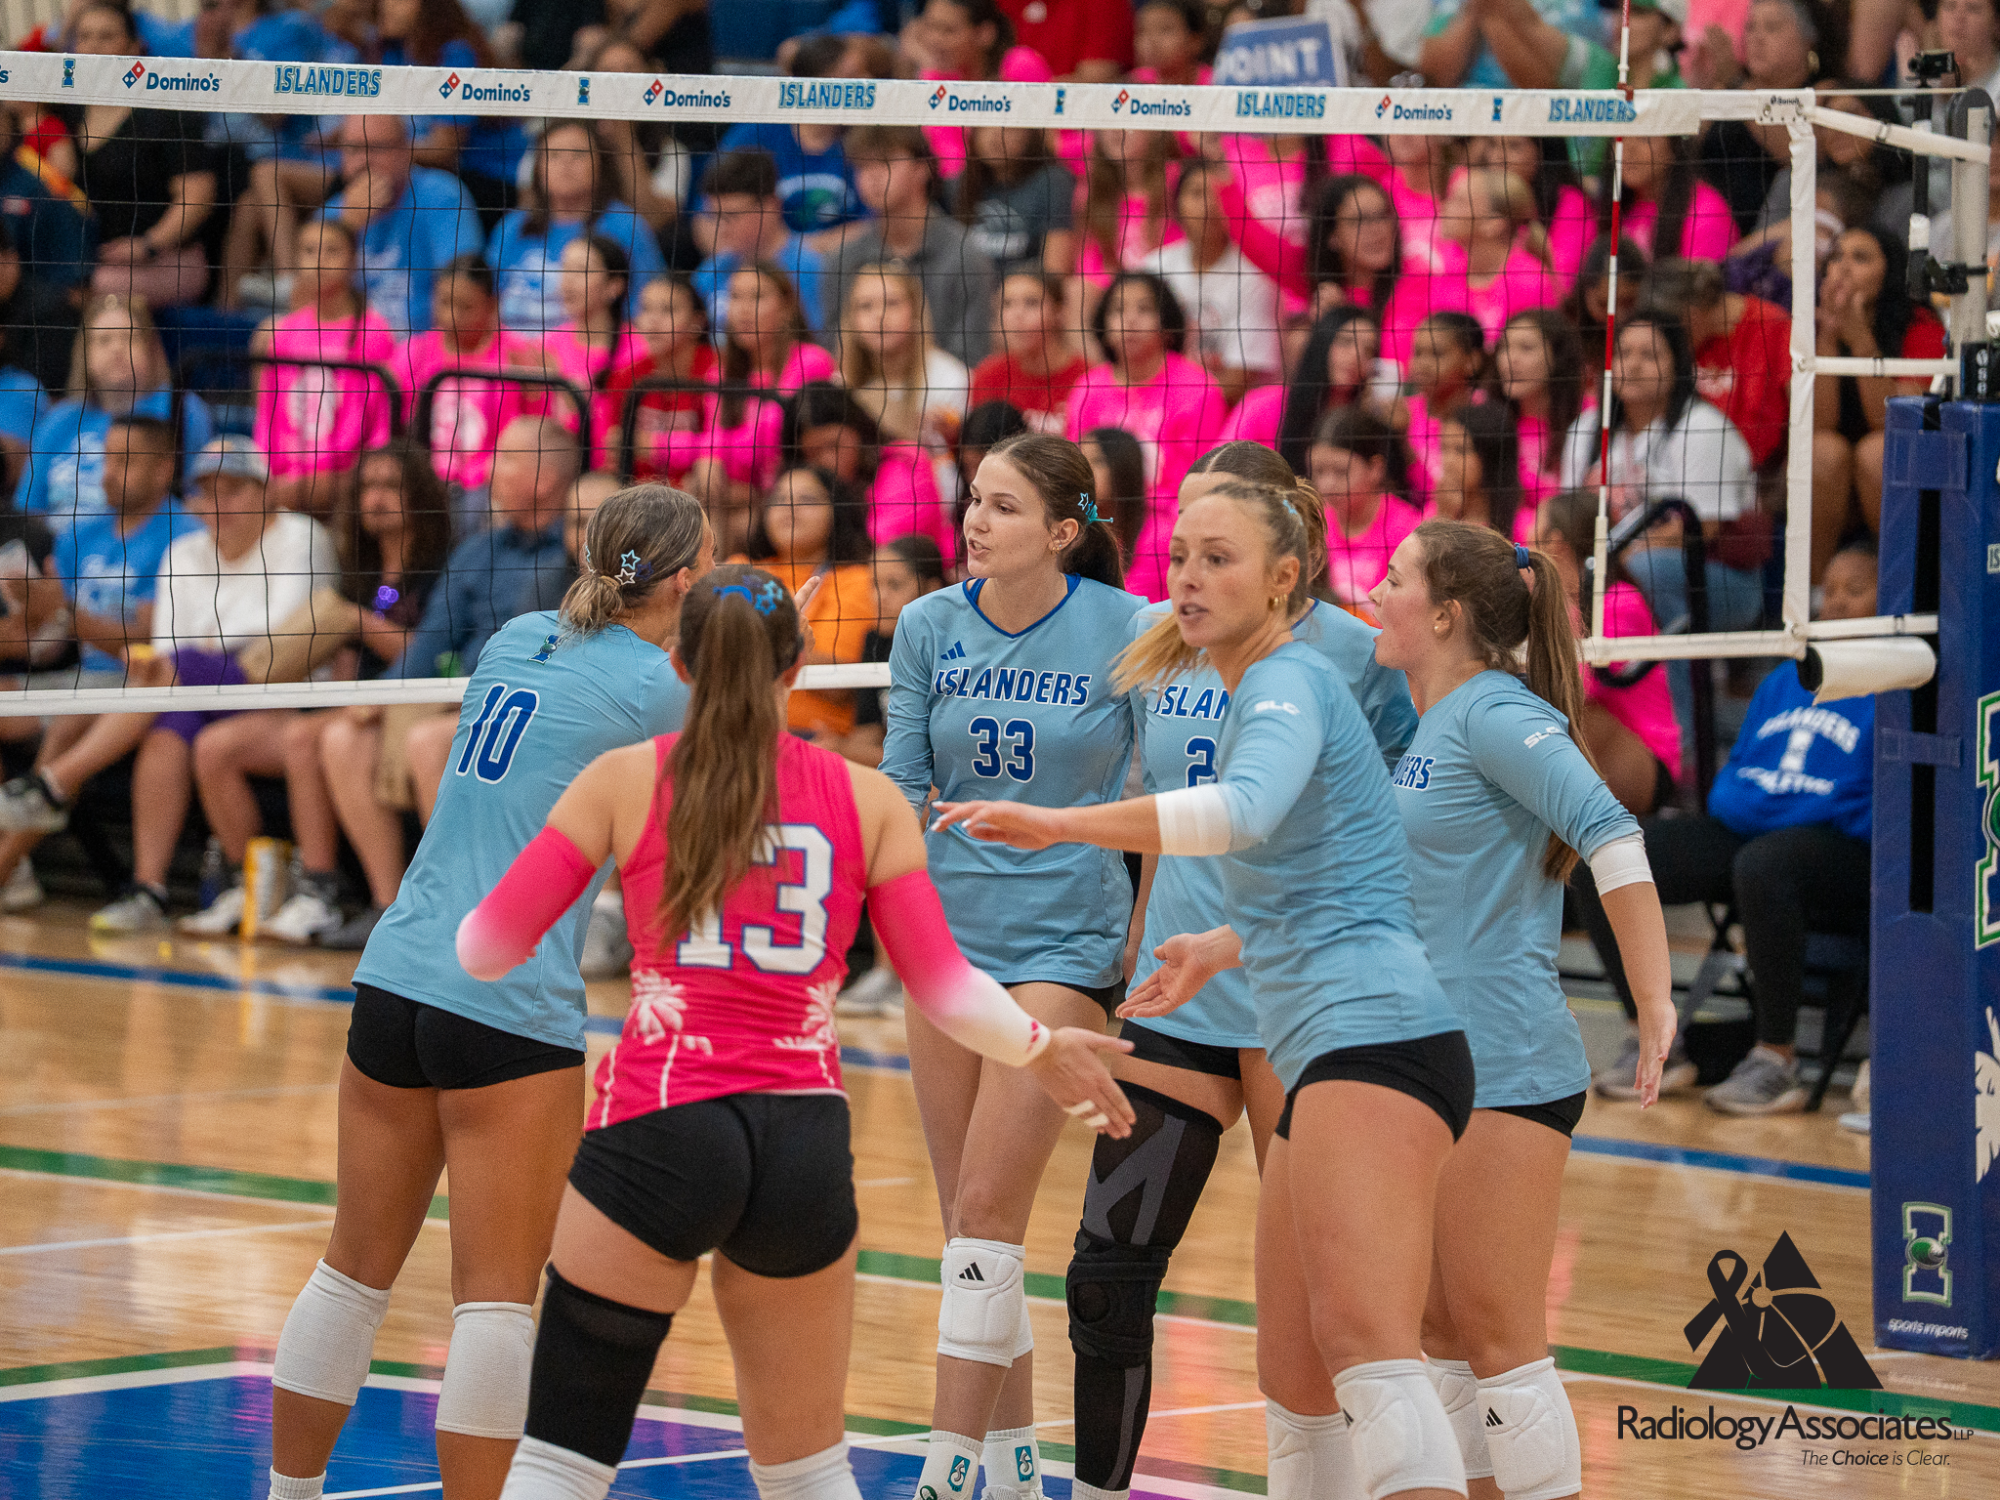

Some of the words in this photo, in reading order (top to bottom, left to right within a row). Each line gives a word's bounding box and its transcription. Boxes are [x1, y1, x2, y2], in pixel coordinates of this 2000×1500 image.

[146, 72, 220, 92] Domino's
[274, 65, 382, 98] ISLANDERS
[462, 83, 530, 102] Domino's
[663, 89, 731, 108] Domino's
[778, 81, 876, 109] ISLANDERS
[948, 95, 1011, 112] Domino's
[1235, 91, 1326, 118] ISLANDERS
[1130, 99, 1192, 116] Domino's
[1393, 104, 1453, 121] Domino's
[1547, 97, 1637, 122] ISLANDERS
[934, 666, 1092, 706] ISLANDERS
[456, 683, 540, 784] 10
[968, 716, 1036, 783] 33
[1888, 1318, 1924, 1334] sports
[1923, 1323, 1969, 1340] imports
